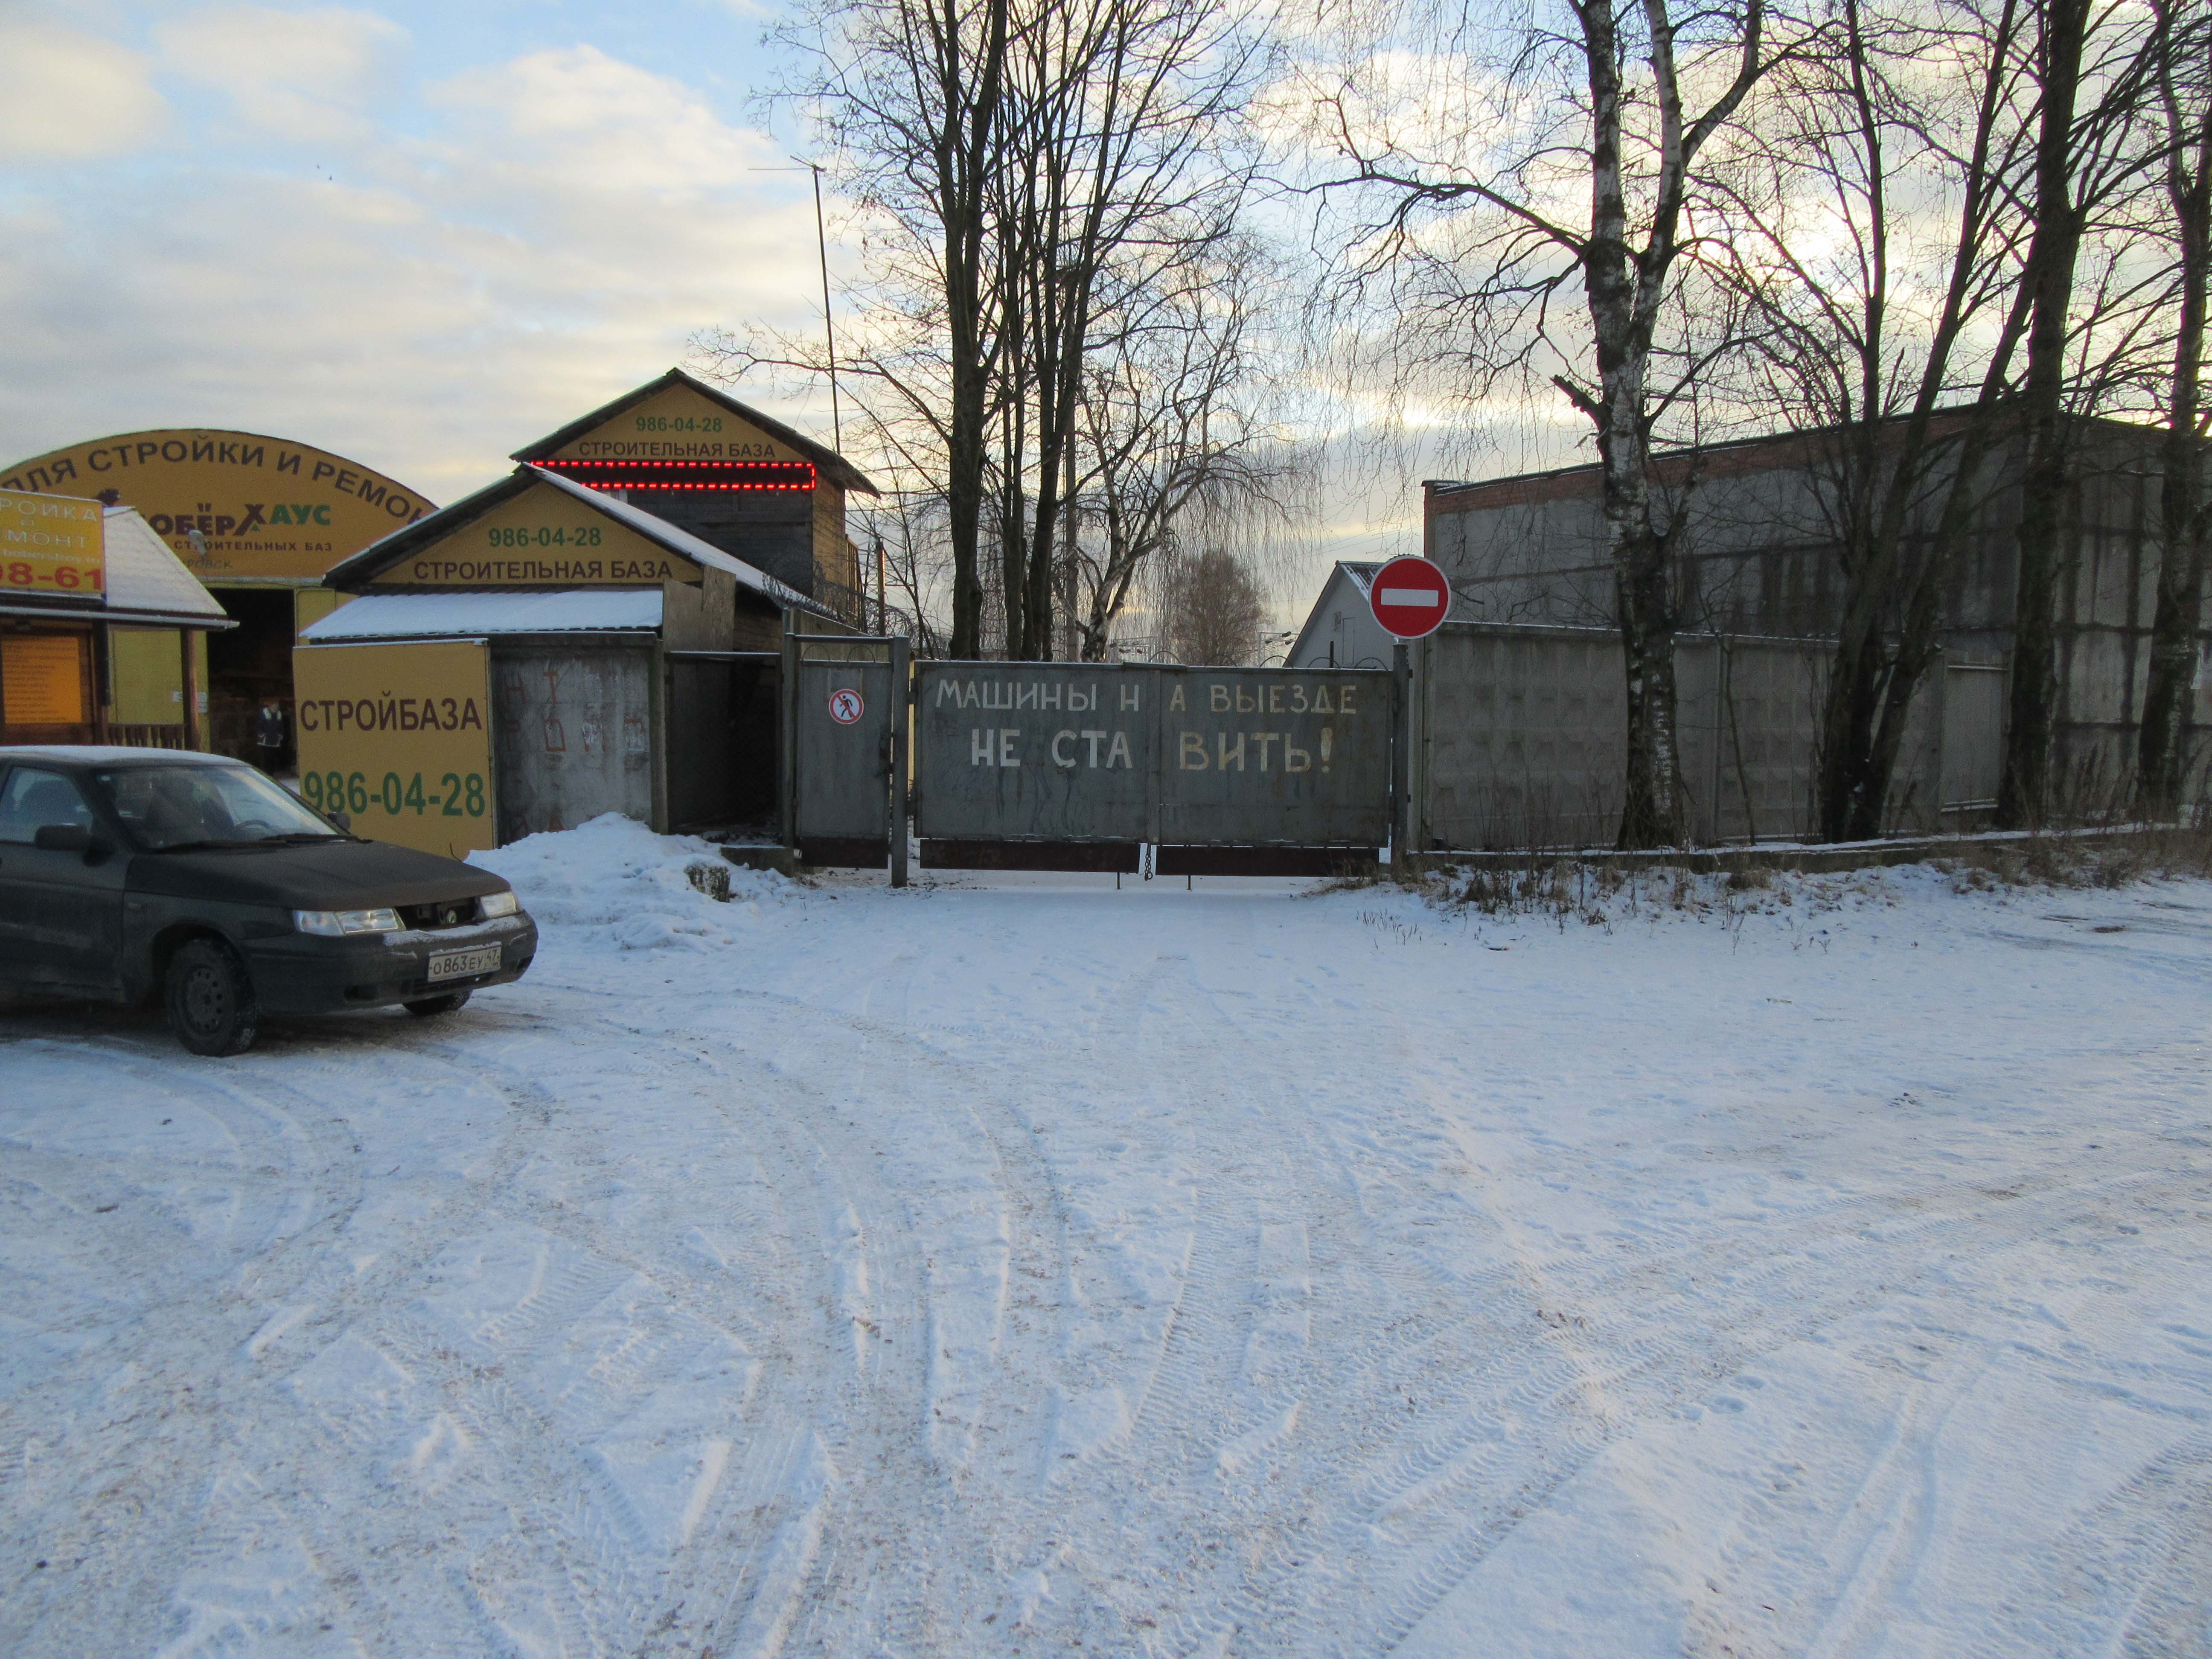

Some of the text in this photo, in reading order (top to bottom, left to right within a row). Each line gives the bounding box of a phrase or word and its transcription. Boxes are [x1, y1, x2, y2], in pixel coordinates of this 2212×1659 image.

[636, 416, 722, 432] 986-04-28
[88, 434, 265, 472] СТРОЙКИ
[277, 451, 302, 475] И
[579, 441, 776, 458] СТРОИТЕЛЬНАЯ БАЗА
[174, 540, 332, 552] СТОИТЕЛЬНЫХ БАЗ
[489, 527, 602, 547] 986-04-28
[0, 562, 102, 590] 8-61
[414, 560, 672, 579] СТРОИТЕЛЬНАЯ БАЗА
[300, 690, 483, 731] СТРОЙБАЗА
[936, 679, 1096, 712] МАШИНЫ
[1210, 684, 1357, 714] ВЫЕЗДЕ
[971, 728, 1021, 767] НЕ
[304, 771, 486, 818] 986-04-28
